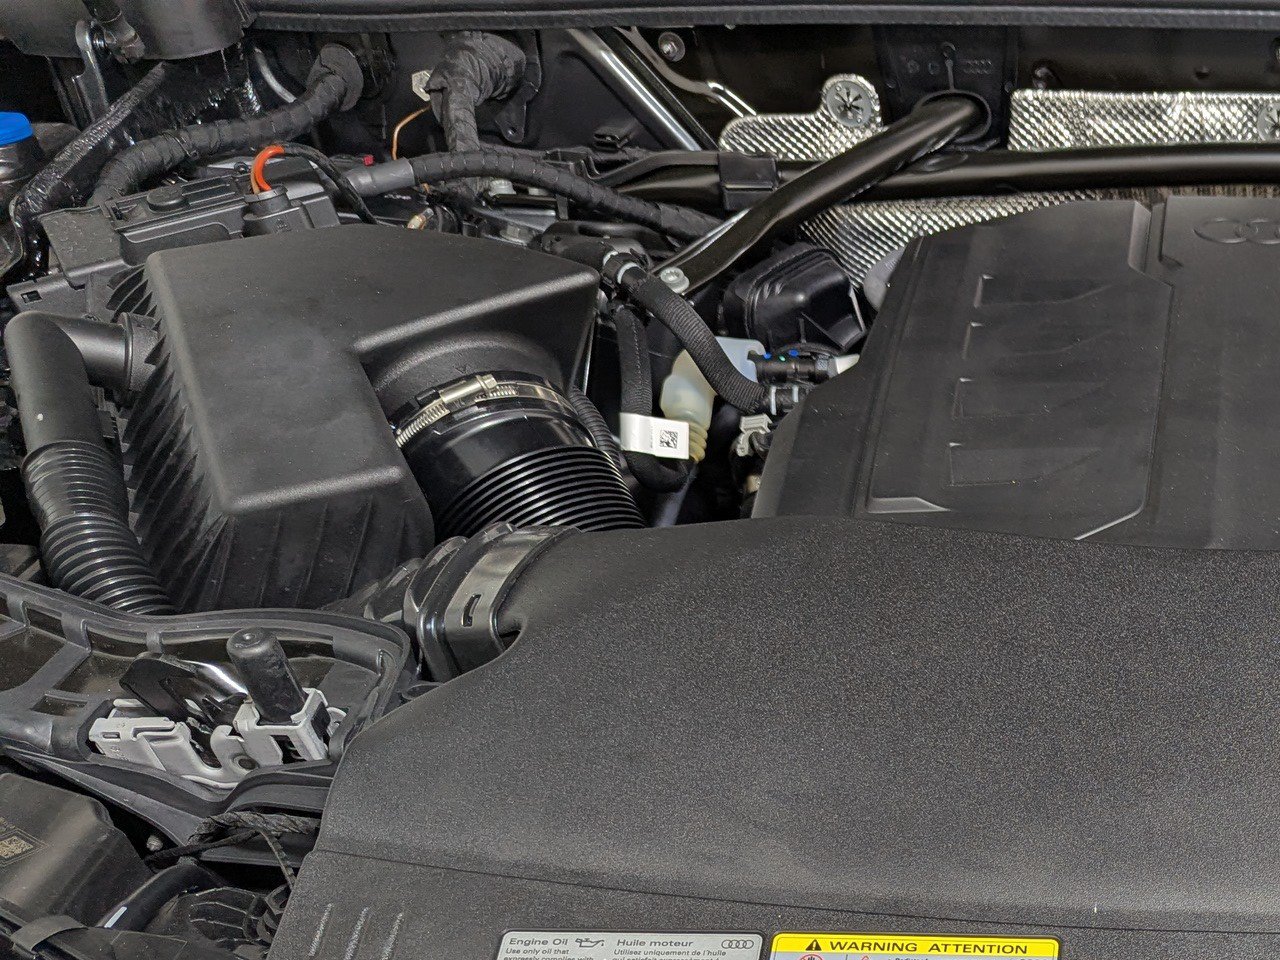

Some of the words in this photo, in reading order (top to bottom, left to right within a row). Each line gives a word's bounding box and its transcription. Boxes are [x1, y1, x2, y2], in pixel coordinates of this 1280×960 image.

[509, 938, 548, 946] Engine
[830, 941, 918, 952] WARNING
[928, 943, 1028, 954] ATTENTION
